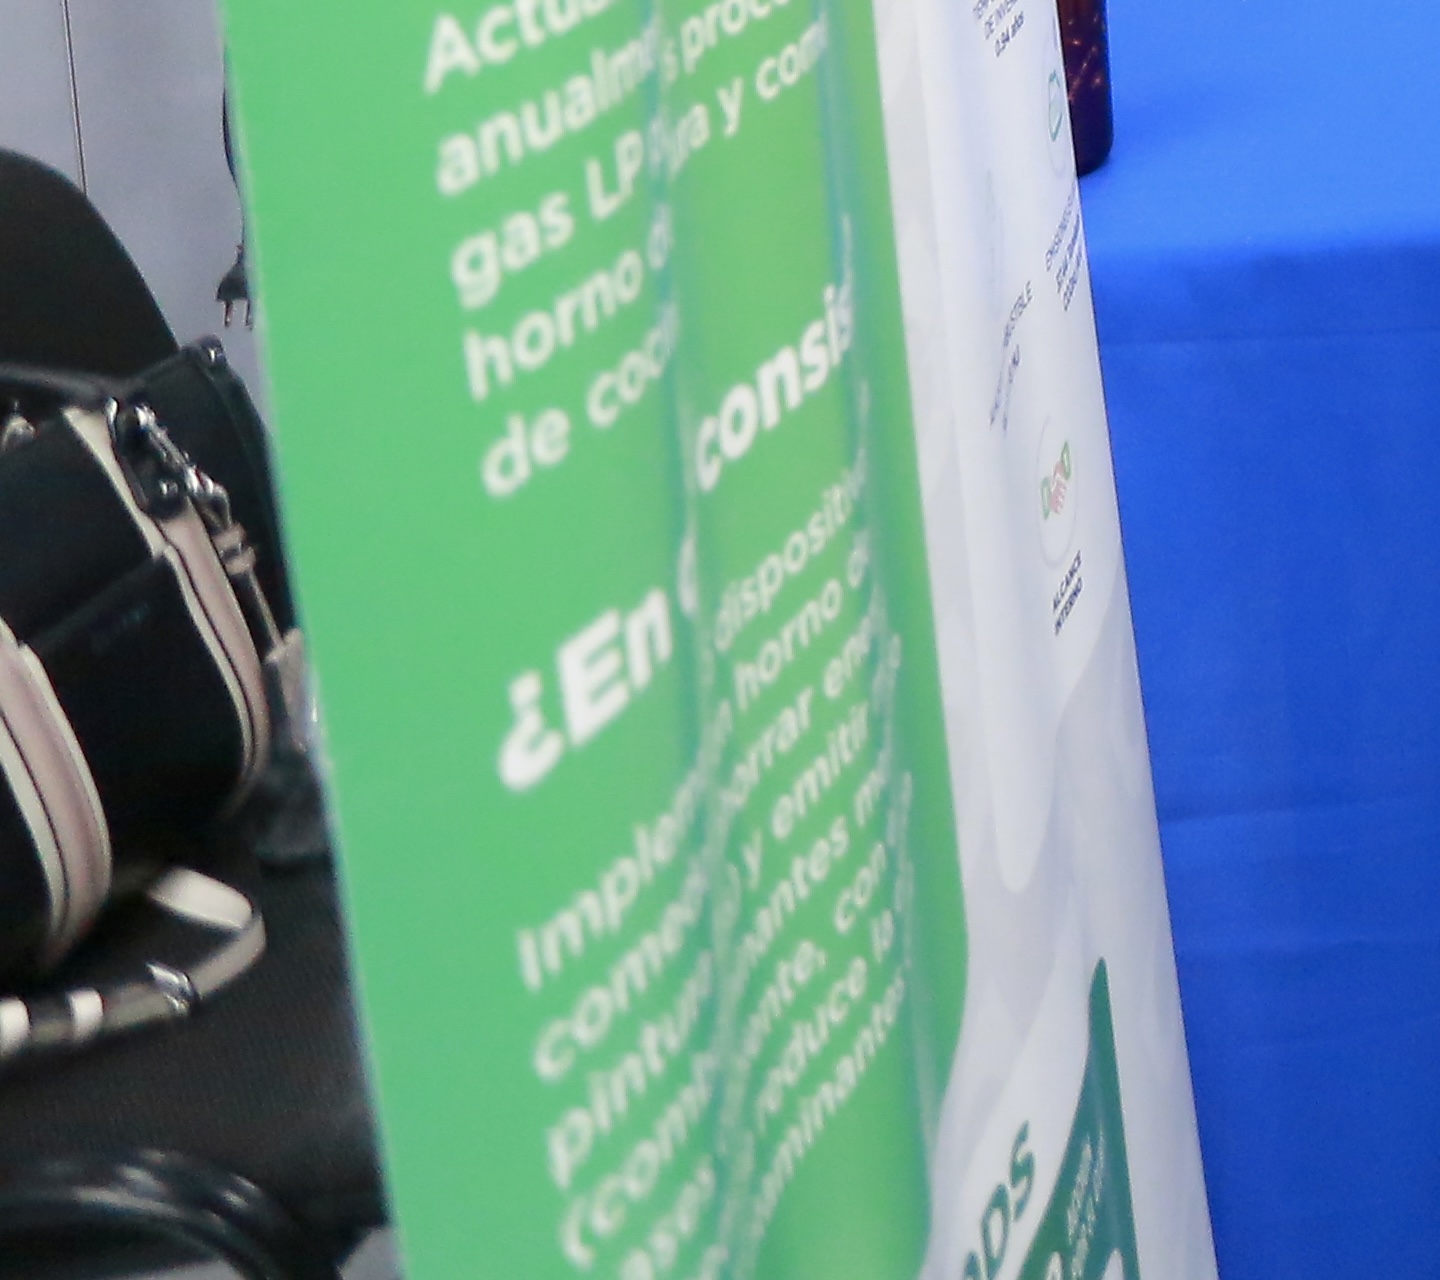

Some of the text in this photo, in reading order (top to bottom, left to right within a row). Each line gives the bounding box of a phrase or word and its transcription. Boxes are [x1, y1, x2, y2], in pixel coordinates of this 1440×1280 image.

[450, 190, 575, 310] gas
[462, 248, 645, 403] horno
[480, 407, 571, 501] de
[496, 585, 672, 794] ¿En
